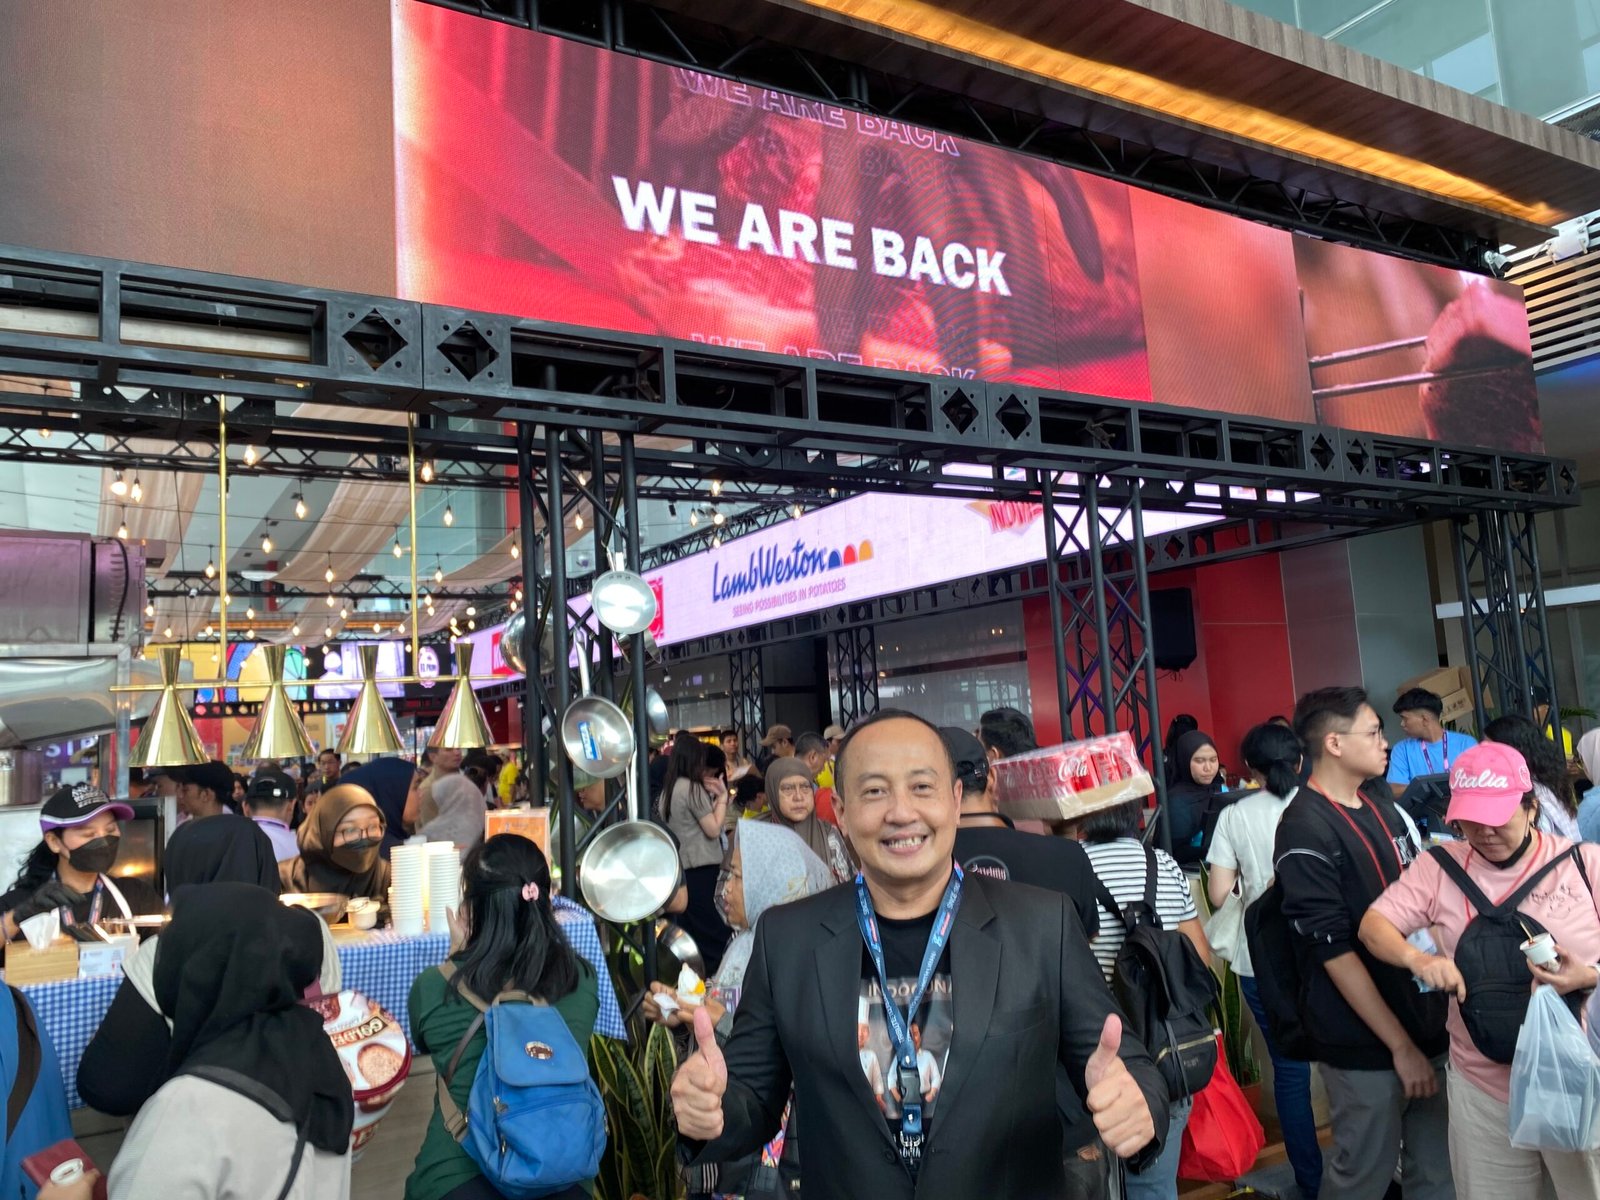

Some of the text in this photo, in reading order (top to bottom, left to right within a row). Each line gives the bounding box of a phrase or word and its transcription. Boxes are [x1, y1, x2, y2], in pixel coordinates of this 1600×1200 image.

[611, 174, 1012, 298] WE ARE BACK
[732, 578, 847, 619] SEEING POSSIBILITIES IN POTATOES
[1450, 767, 1508, 790] Italia
